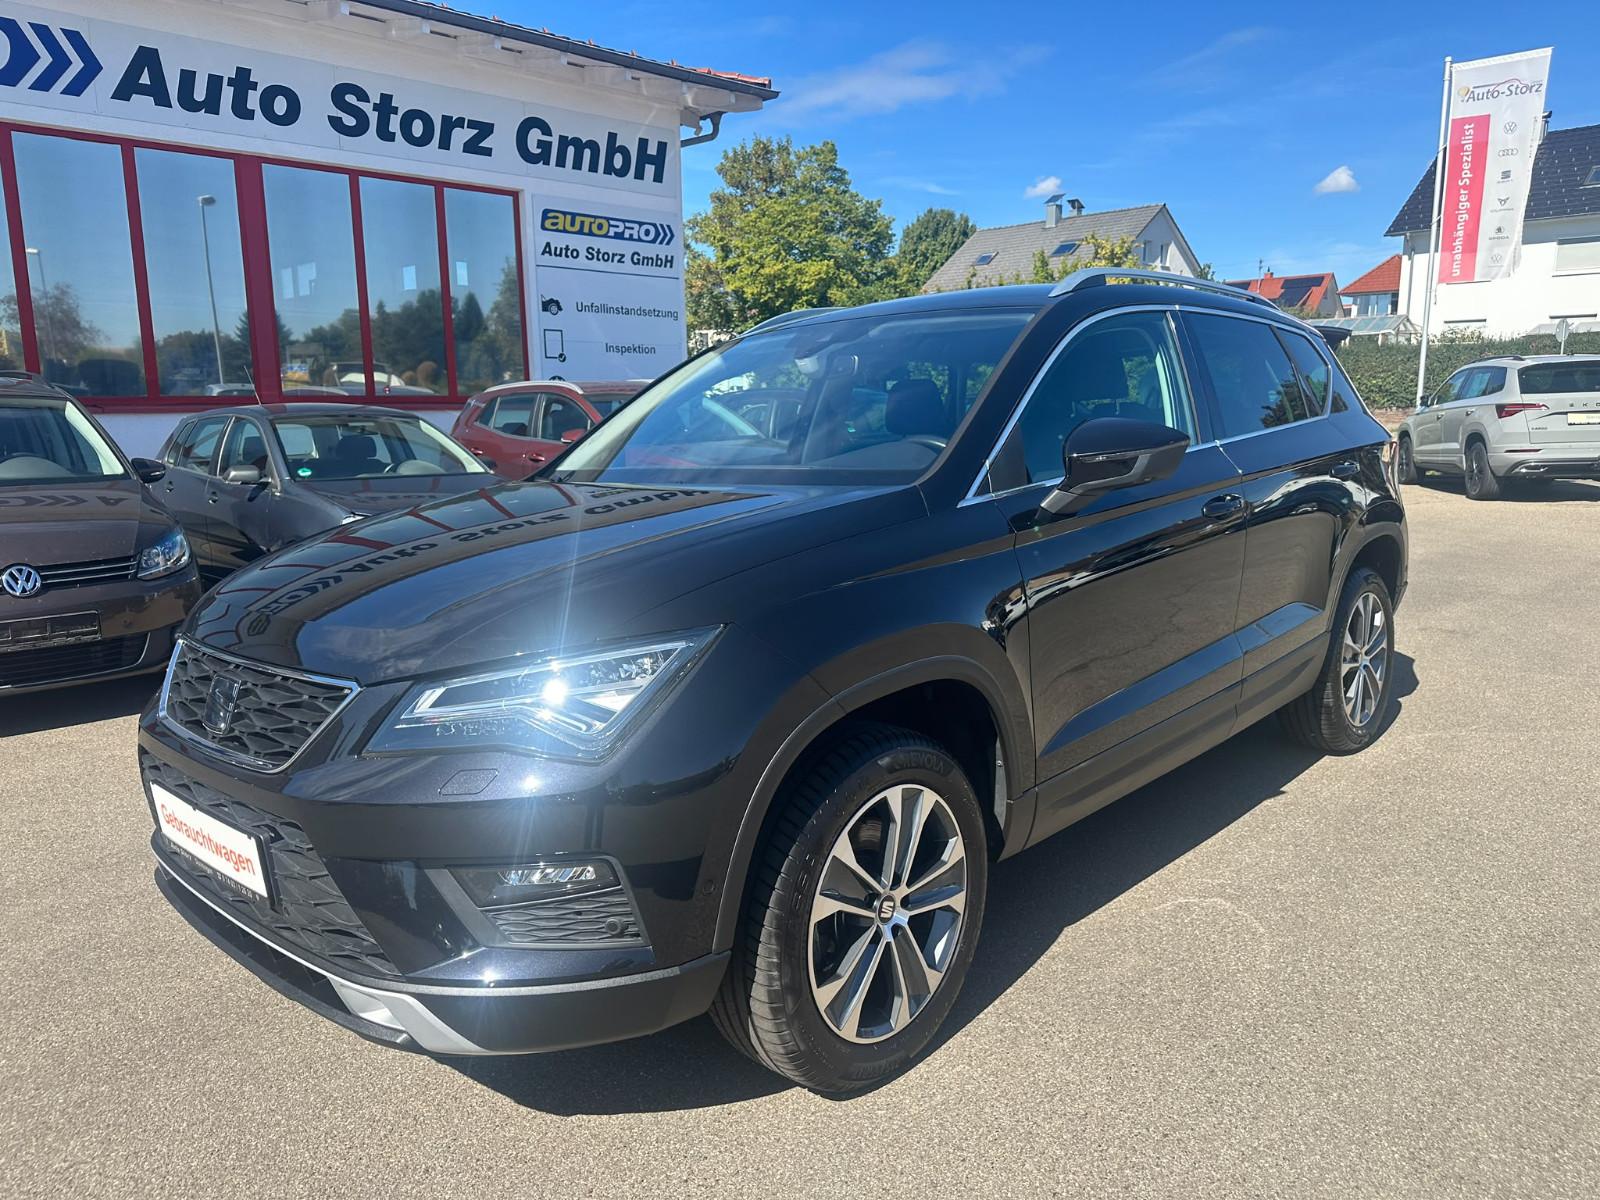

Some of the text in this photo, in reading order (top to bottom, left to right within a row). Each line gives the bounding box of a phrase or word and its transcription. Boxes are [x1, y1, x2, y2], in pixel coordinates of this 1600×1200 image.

[1466, 83, 1543, 103] Auto-Storz
[110, 45, 668, 184] Auto Storz GmbH
[1451, 123, 1475, 278] unabhängiger Spezialist
[540, 241, 675, 269] Auto Storz GmbH
[575, 301, 679, 321] Unfallinstandsetzung
[604, 342, 656, 356] Inspektion
[160, 803, 256, 876] Gebrauchtwagen
